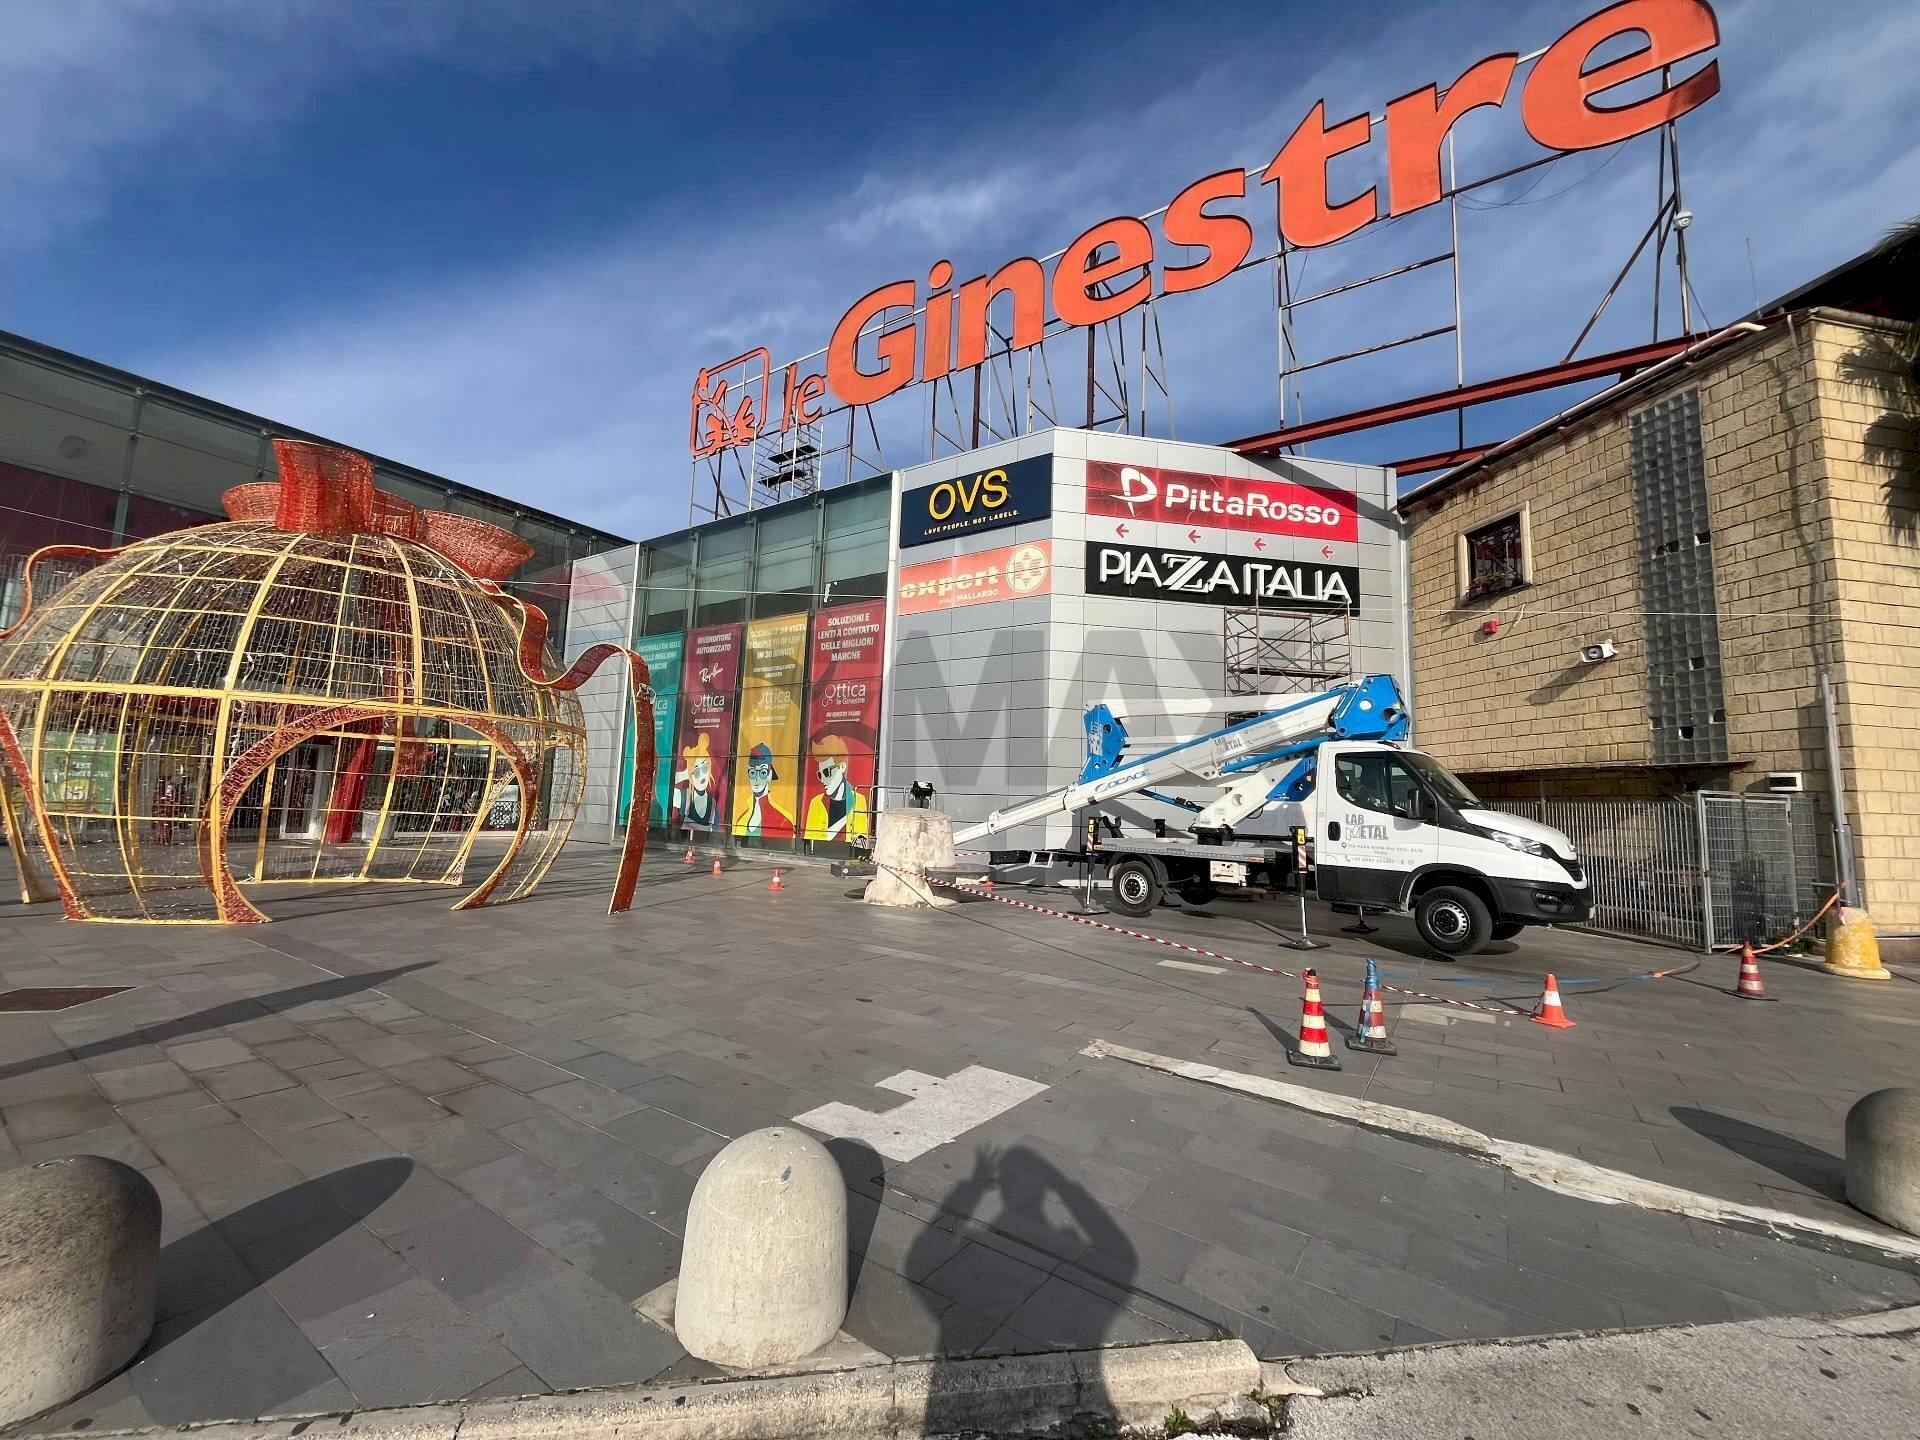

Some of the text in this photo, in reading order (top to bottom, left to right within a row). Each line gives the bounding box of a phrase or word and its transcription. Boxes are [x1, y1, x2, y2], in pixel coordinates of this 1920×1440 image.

[781, 0, 1720, 433] le Ginestre
[928, 469, 1008, 520] OVS
[1165, 483, 1340, 526] PittaRosso
[924, 527, 940, 536] LOVE
[972, 516, 987, 525] NOT
[900, 565, 999, 599] expert
[1100, 549, 1352, 604] PIAZZA ITALIA
[828, 614, 864, 626] SOLUZIONI
[818, 629, 836, 640] LENTI
[843, 624, 879, 637] CONTATTO
[821, 637, 874, 651] DELLE MIGLIORI
[830, 650, 861, 662] MARCHE
[825, 680, 866, 699] Ottica
[694, 692, 725, 707] Ottica
[1345, 813, 1365, 825] LAB
